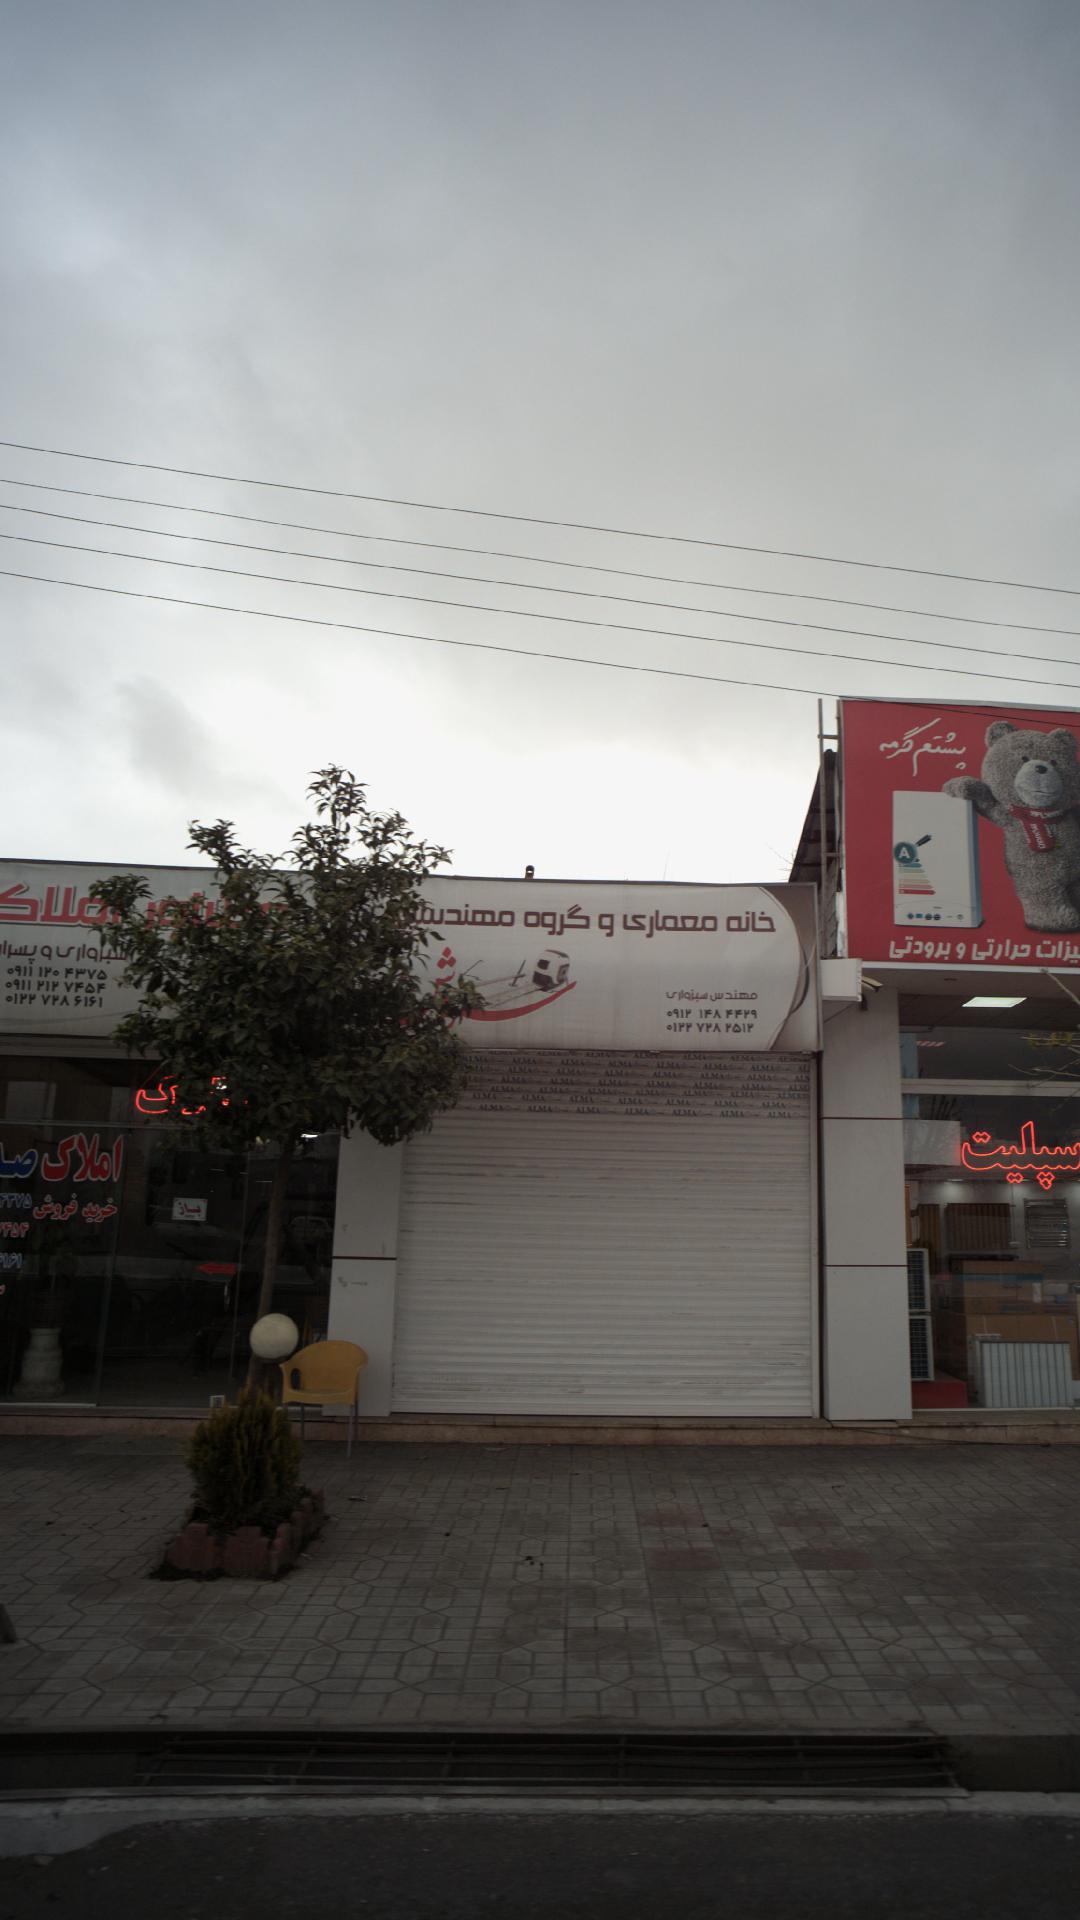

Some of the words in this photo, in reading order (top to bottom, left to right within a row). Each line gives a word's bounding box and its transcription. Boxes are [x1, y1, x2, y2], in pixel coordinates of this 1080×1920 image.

[898, 847, 911, 859] A
[523, 904, 590, 936] گروه
[598, 914, 614, 938] و
[622, 910, 718, 939] معماری
[726, 910, 776, 934] خانه
[40, 945, 52, 961] و
[888, 935, 951, 960] برودتی
[955, 942, 966, 960] و
[970, 938, 1031, 961] حرارتی
[1035, 940, 1080, 964] یزات
[7, 965, 33, 977] ۰۹۱۱
[64, 967, 107, 980] ۴۳۷۵
[5, 978, 31, 991] ۰۹۱۱
[37, 980, 59, 992] ۲۱۲
[64, 981, 106, 994] ۷۴۵۴
[709, 989, 758, 1002] مهندس
[5, 993, 36, 1005] ۰۱۲۲
[41, 994, 70, 1006] ۷۲۸
[74, 995, 103, 1008] ۶۱۶۱
[666, 1008, 692, 1019] ۰۹۱۲
[699, 1008, 721, 1019] ۱۴۸
[725, 1009, 758, 1019] ۴۴۲۹
[666, 1022, 692, 1033] ۰۱۲۲
[696, 1022, 721, 1033] ۷۲۸
[725, 1023, 754, 1033] ۲۵۱۲
[41, 1132, 124, 1182] املاک
[33, 1192, 79, 1220] فروش
[81, 1197, 118, 1222] خرید
